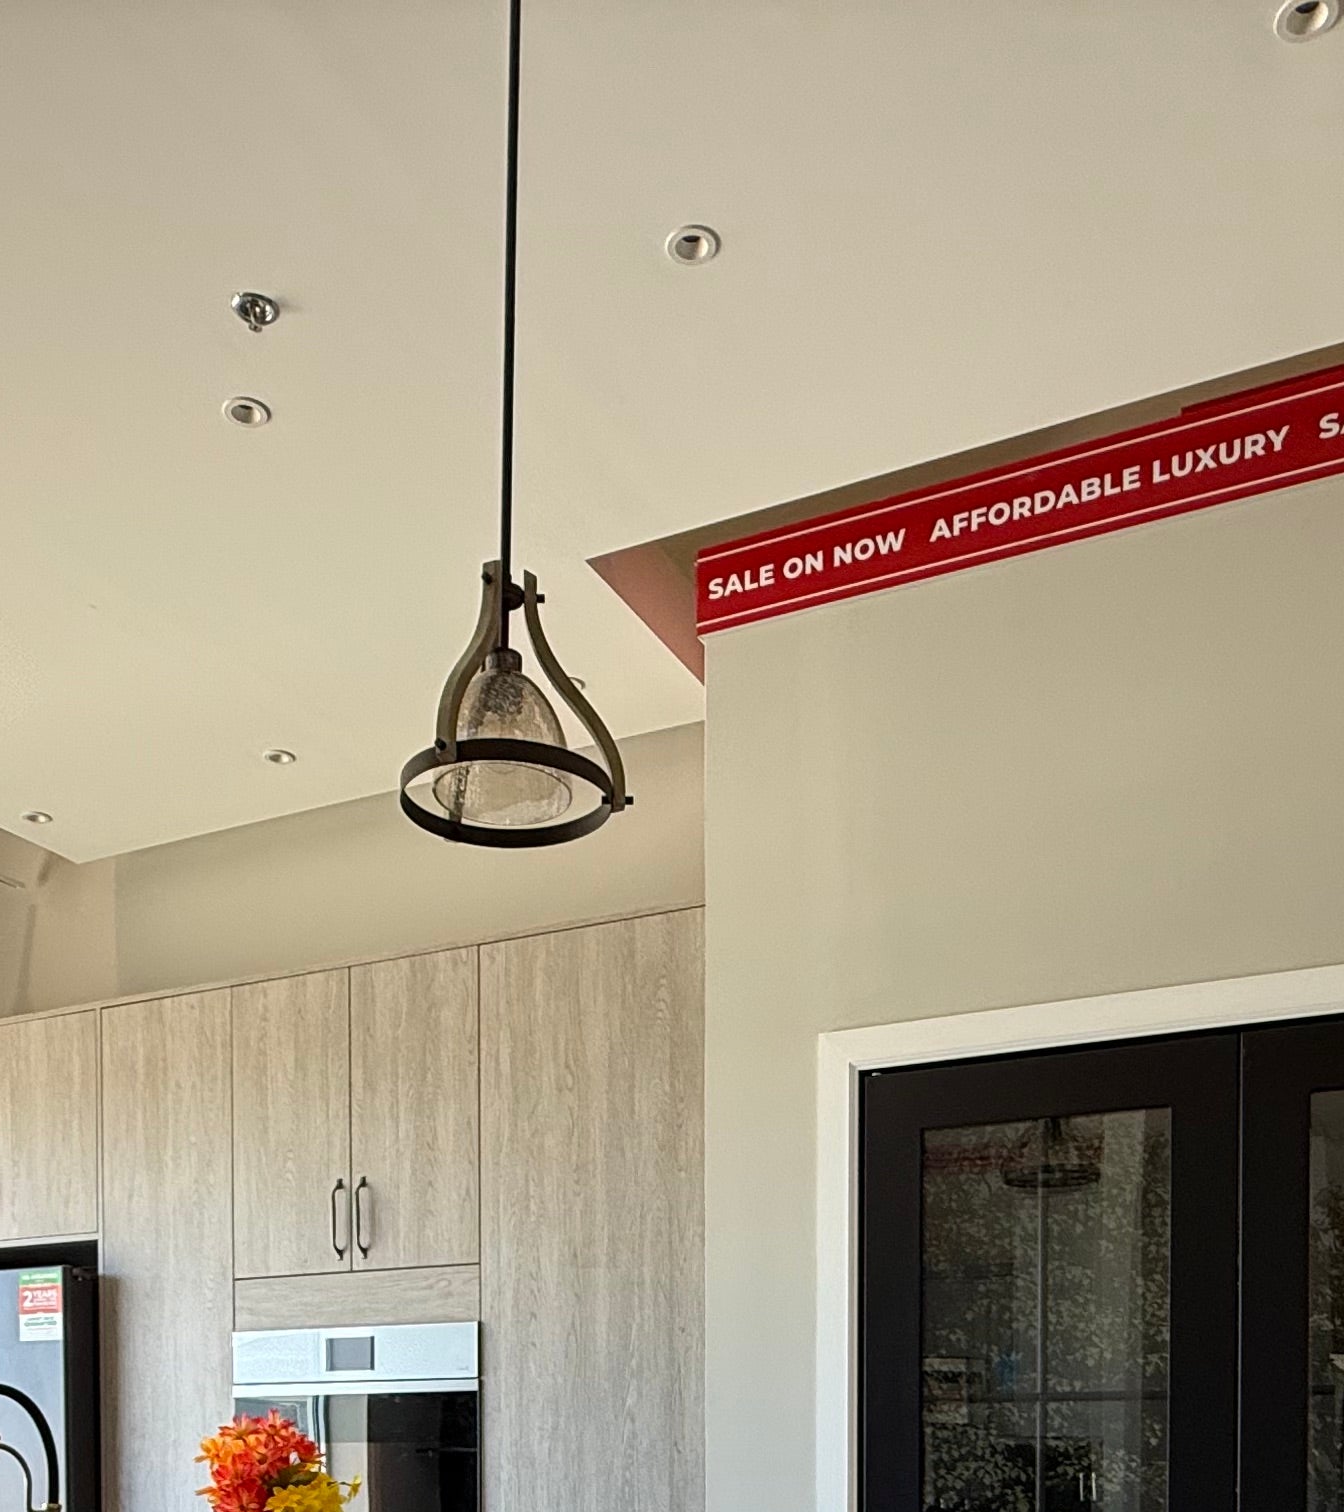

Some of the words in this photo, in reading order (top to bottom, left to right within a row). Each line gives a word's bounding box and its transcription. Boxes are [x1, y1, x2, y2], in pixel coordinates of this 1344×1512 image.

[708, 563, 775, 600] SALE
[782, 550, 824, 580] ON
[833, 528, 906, 568] NOW
[929, 465, 1141, 543] AFFORDABLE
[1152, 425, 1290, 484] LUXURY
